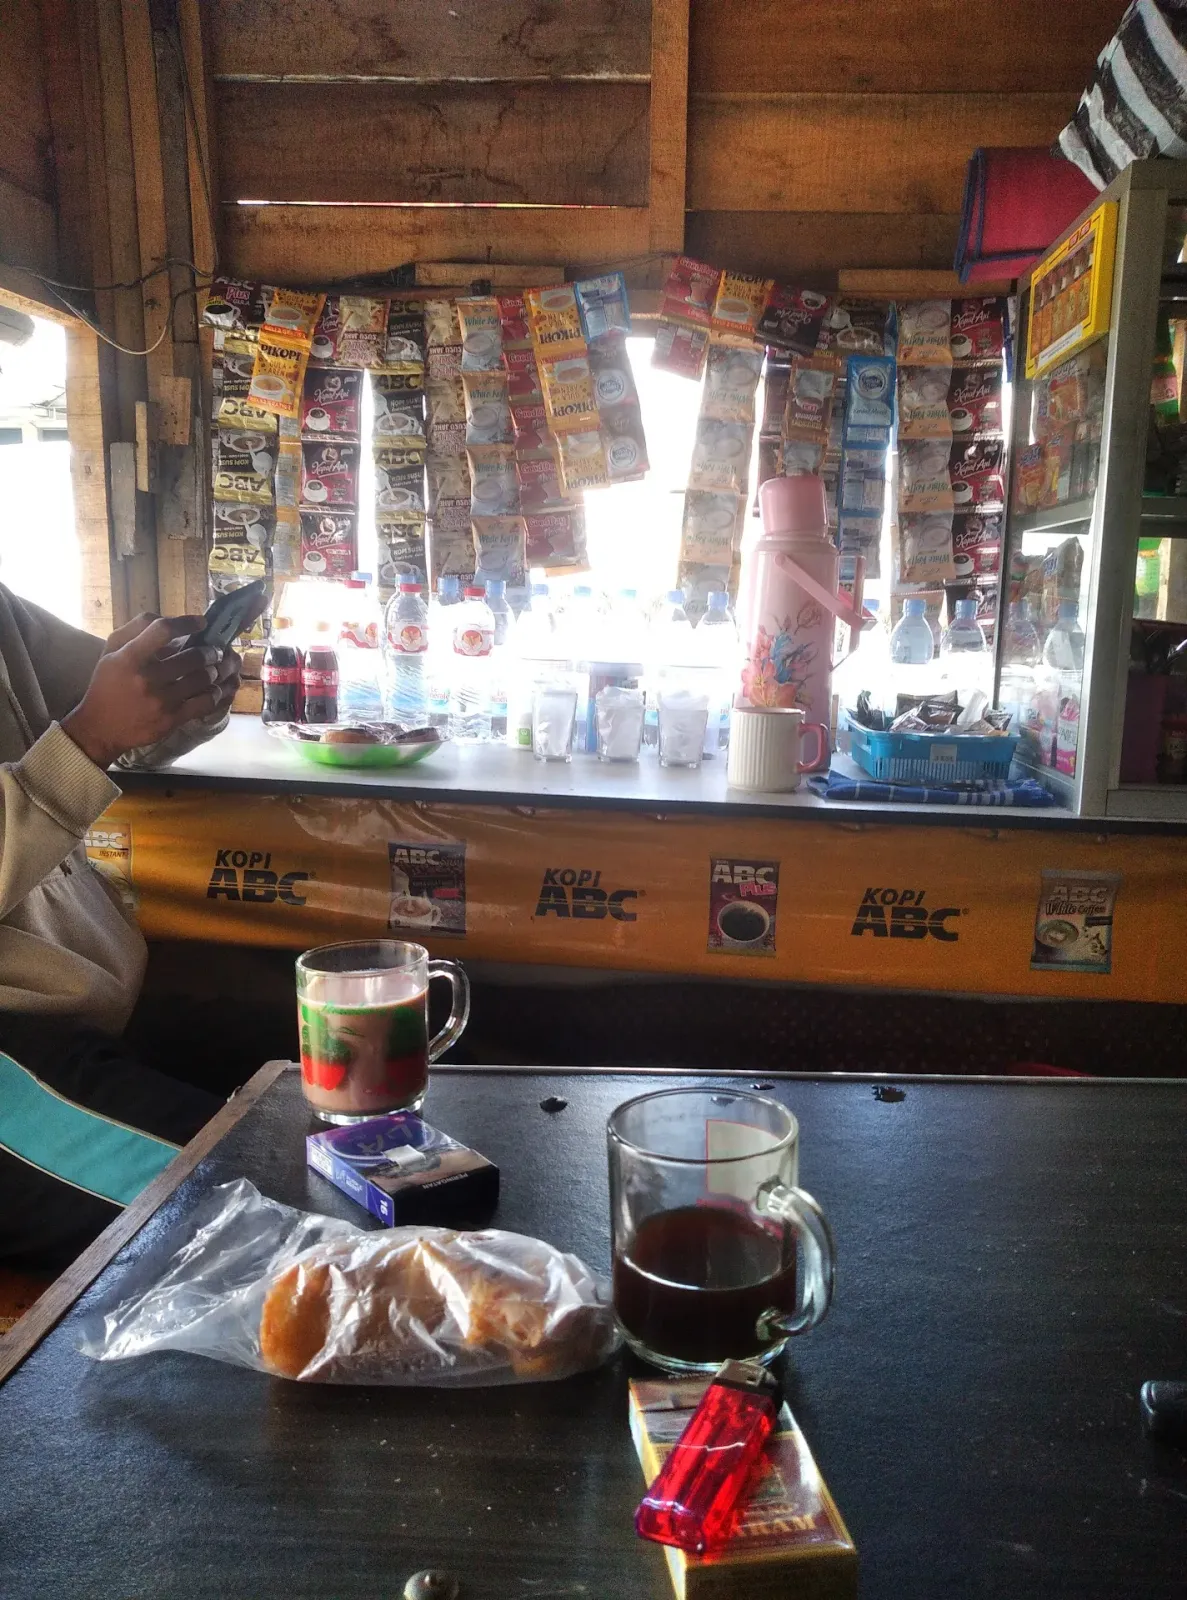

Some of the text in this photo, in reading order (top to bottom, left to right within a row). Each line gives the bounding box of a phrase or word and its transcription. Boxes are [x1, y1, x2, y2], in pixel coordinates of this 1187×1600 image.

[540, 328, 581, 345] PIKOPI
[260, 343, 302, 361] PIKOPI
[314, 386, 337, 404] Kapal
[552, 400, 595, 418] PIKOPI
[312, 461, 334, 477] Kapal
[954, 458, 992, 477] Kapal Api
[219, 474, 267, 493] ABC
[310, 532, 333, 548] Kapal
[956, 529, 992, 548] Kapal Api
[214, 546, 261, 563] ABC
[215, 849, 272, 869] KOPI
[393, 848, 441, 866] ABC
[543, 867, 602, 887] KOPI
[711, 864, 775, 884] ABC
[206, 868, 310, 905] ABC
[738, 881, 778, 897] Plus
[1047, 885, 1108, 904] ABC
[535, 885, 638, 921] ABC
[862, 887, 927, 906] KOPI
[1045, 902, 1077, 915] White
[850, 904, 962, 942] ABC
[421, 1172, 469, 1190] PERINGATAN
[379, 1199, 389, 1217] 16
